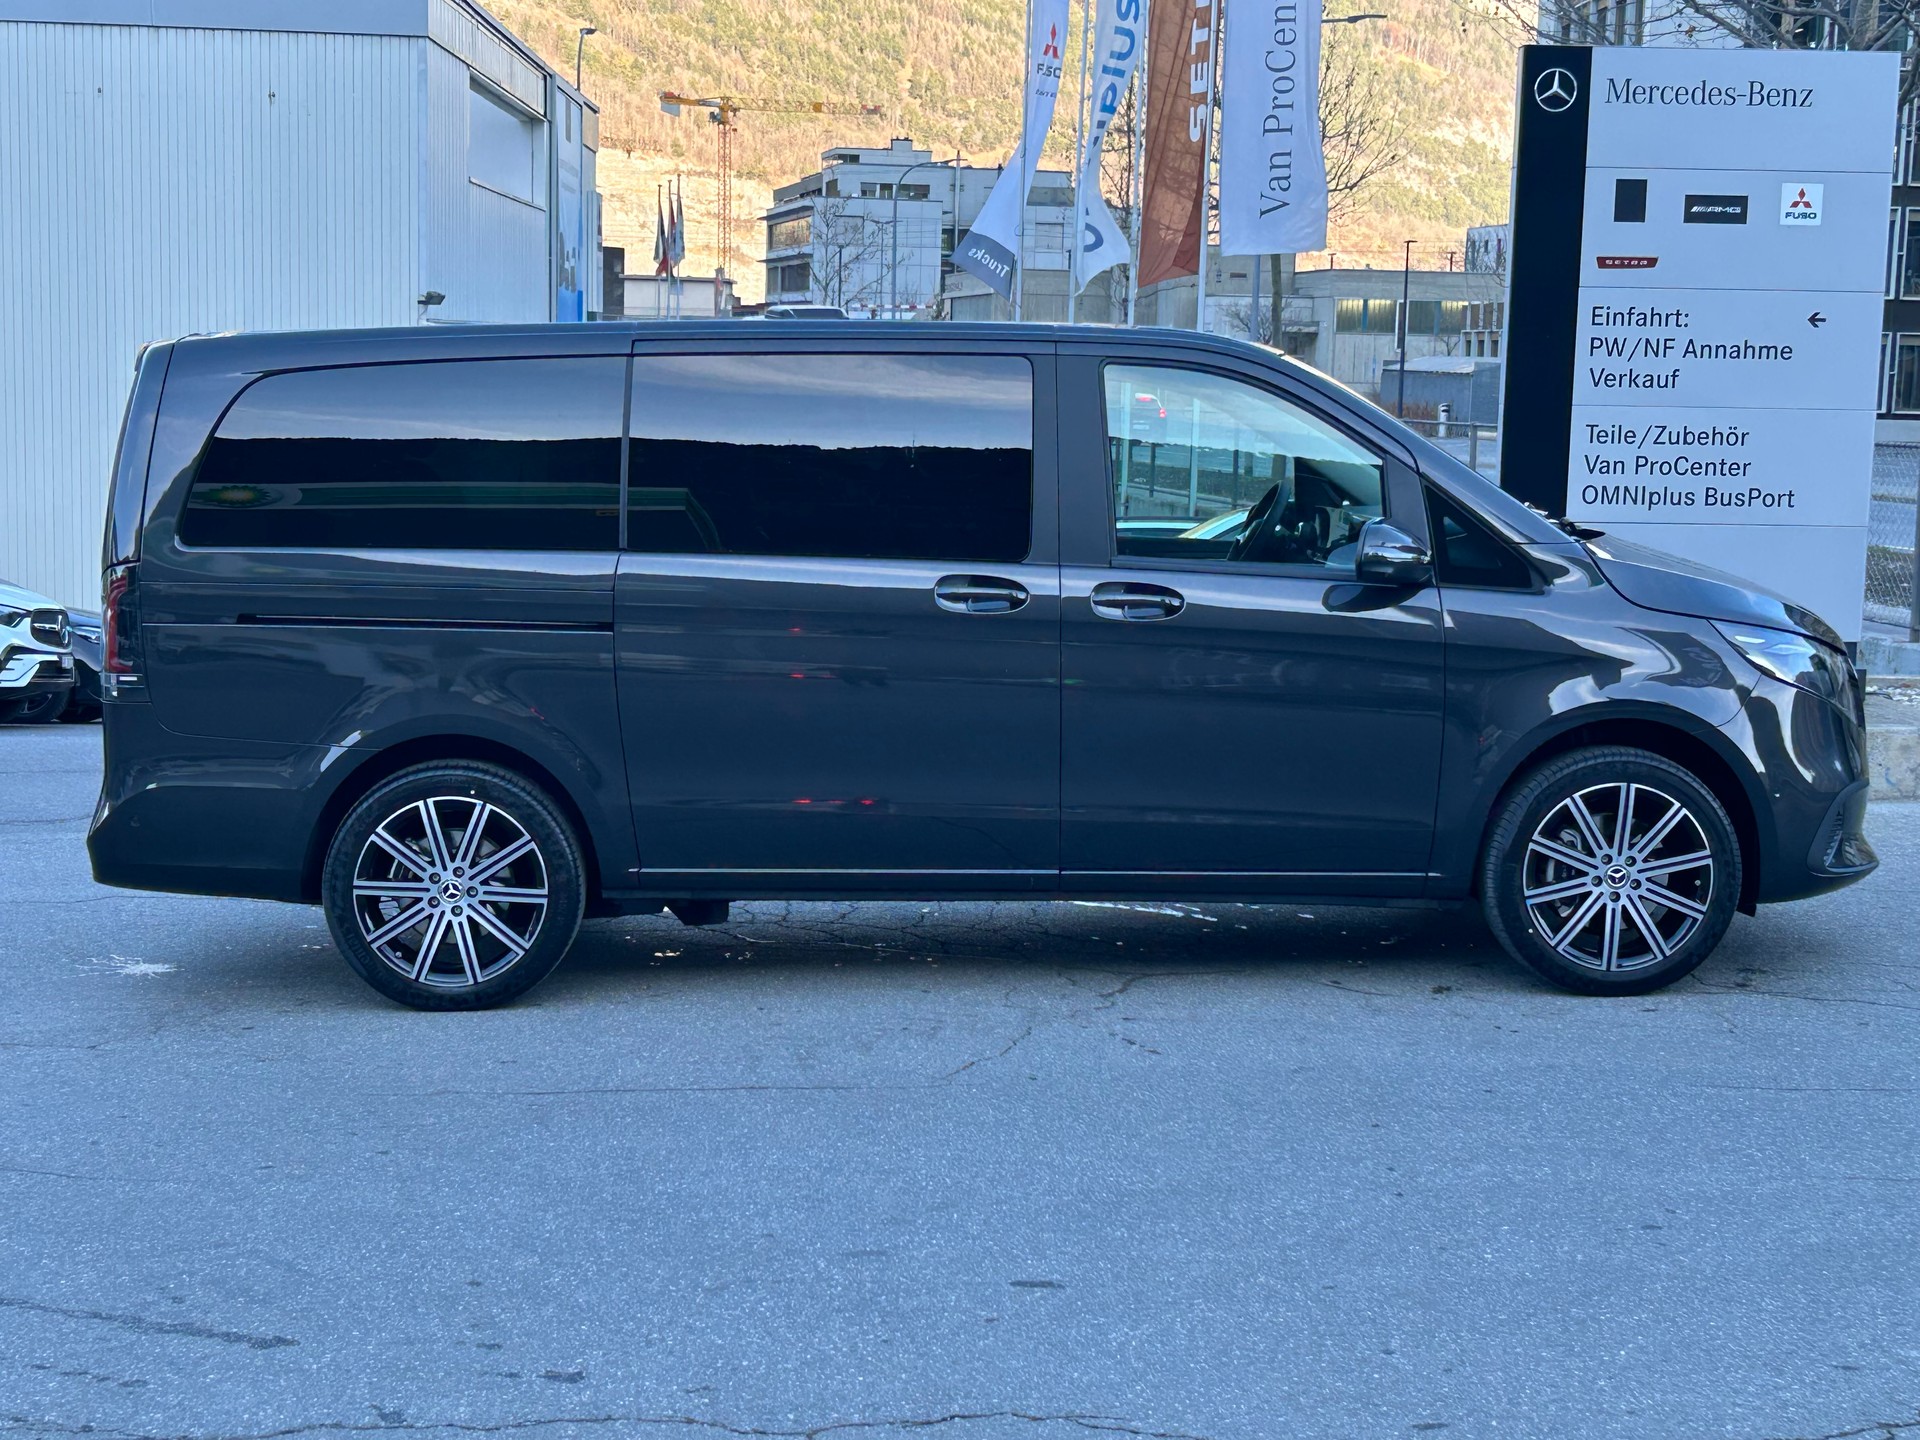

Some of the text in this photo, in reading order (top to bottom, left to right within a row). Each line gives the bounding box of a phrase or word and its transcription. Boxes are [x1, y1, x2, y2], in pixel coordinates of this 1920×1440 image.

[1189, 0, 1210, 142] SET
[1604, 77, 1814, 108] Mercedes-Benz
[1259, 0, 1298, 219] Van ProCen
[1785, 211, 1818, 220] FUSO
[1591, 305, 1689, 328] Einfahrt:
[1589, 336, 1793, 363] PW/NF Annahme
[1589, 367, 1681, 389] Verkauf
[1585, 423, 1750, 450] Teile/Zubehör
[1584, 454, 1752, 477] Van ProCenter
[1581, 484, 1795, 512] OMNIplus BusPort
